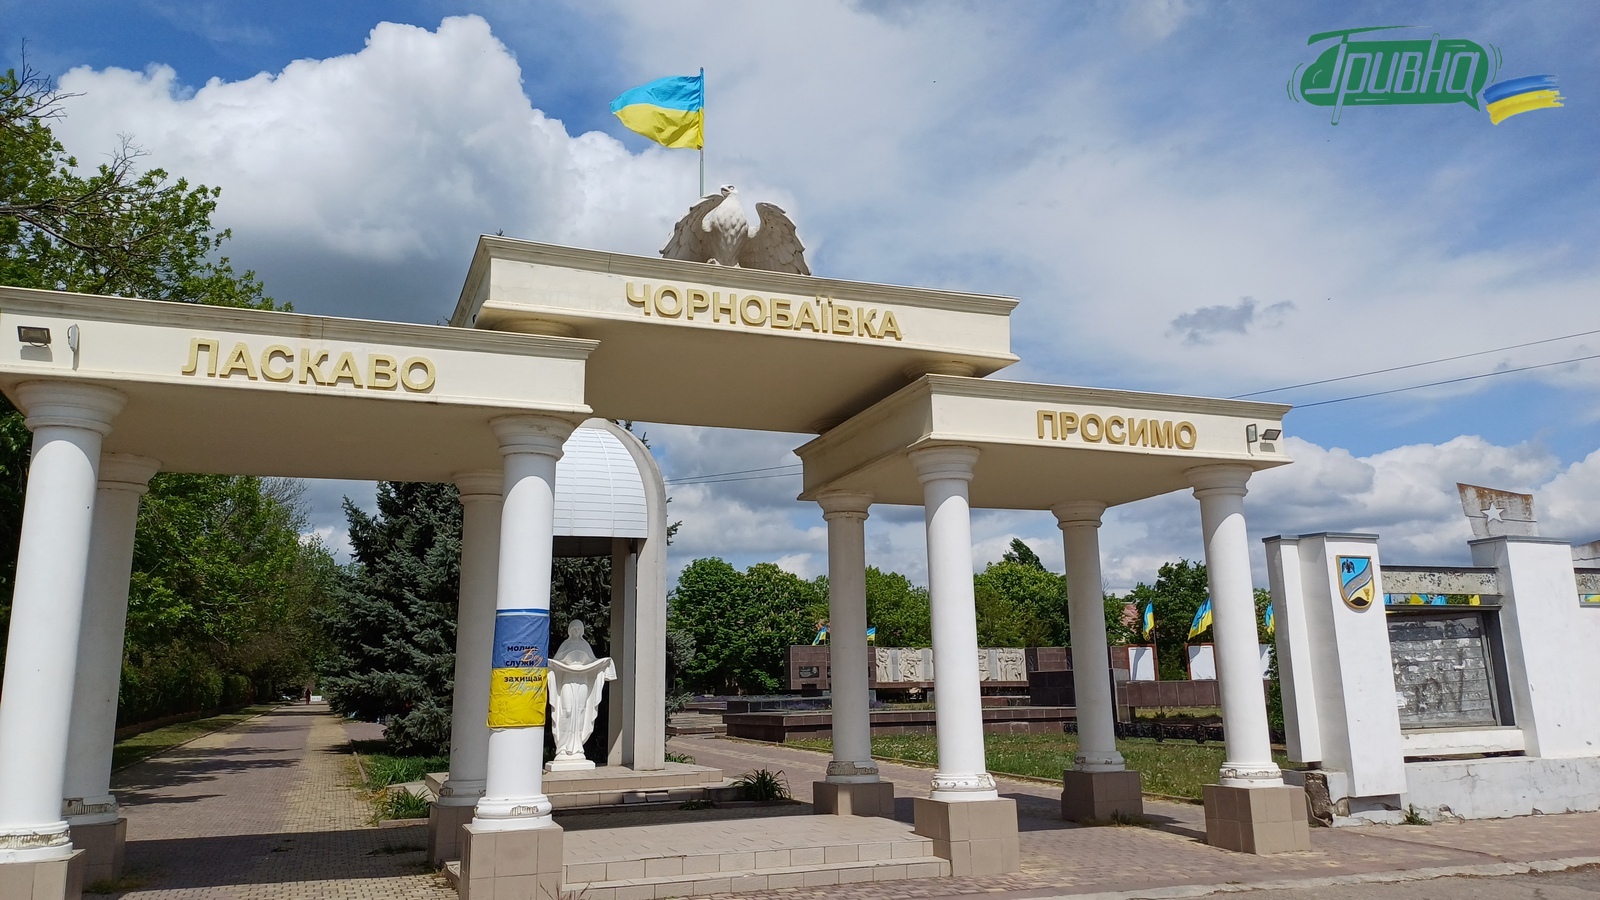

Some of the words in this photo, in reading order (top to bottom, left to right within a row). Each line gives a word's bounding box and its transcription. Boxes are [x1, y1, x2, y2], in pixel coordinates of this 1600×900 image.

[625, 281, 903, 341] ЧОРНОБАЇВКА
[181, 337, 436, 391] ЛАСКАВО
[1036, 409, 1197, 450] ПРОСИМО
[503, 674, 543, 683] захищай
[505, 660, 535, 668] служи
